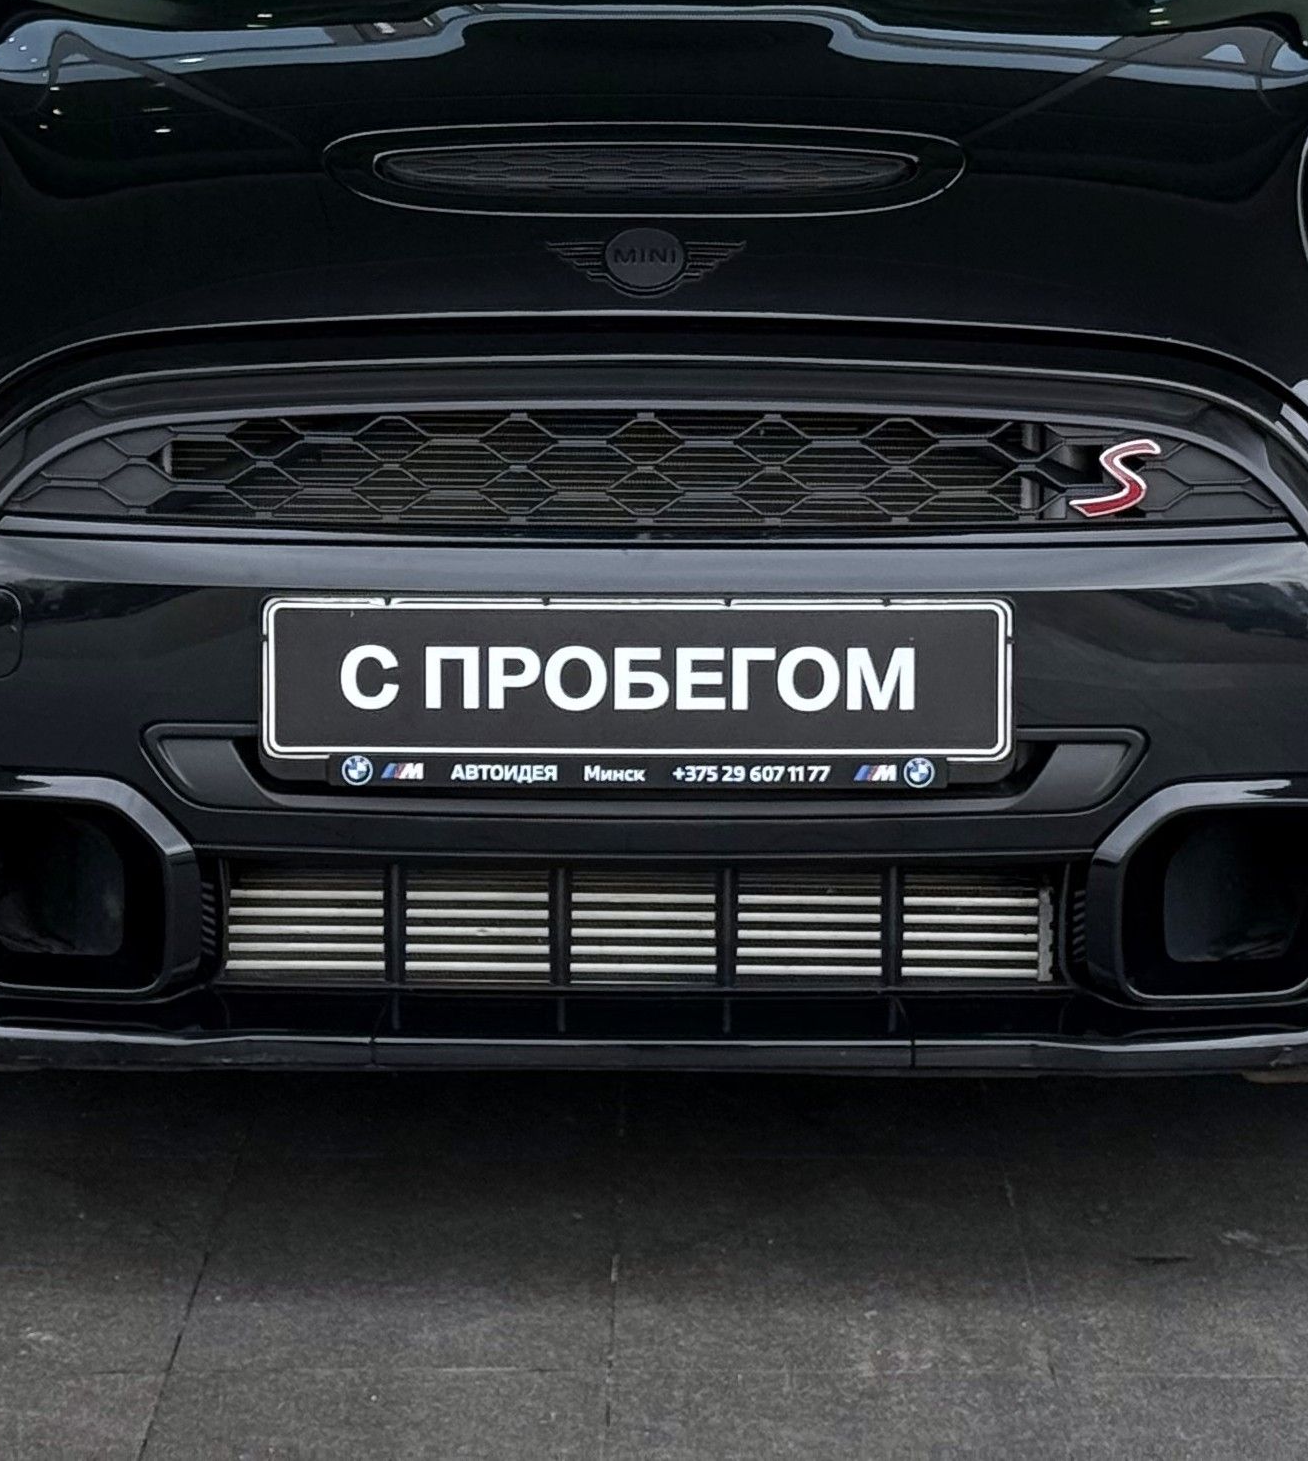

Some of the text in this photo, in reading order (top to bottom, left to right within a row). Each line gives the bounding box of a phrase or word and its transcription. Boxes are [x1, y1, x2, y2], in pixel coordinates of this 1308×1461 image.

[614, 248, 676, 263] MINI
[1069, 439, 1161, 517] S
[340, 644, 916, 712] С ПРОБЕГОМ
[450, 764, 558, 784] АВТОИДЕЯ
[583, 764, 646, 782] Минск
[672, 765, 718, 783] +375
[721, 765, 746, 783] 29
[749, 765, 786, 783] 607
